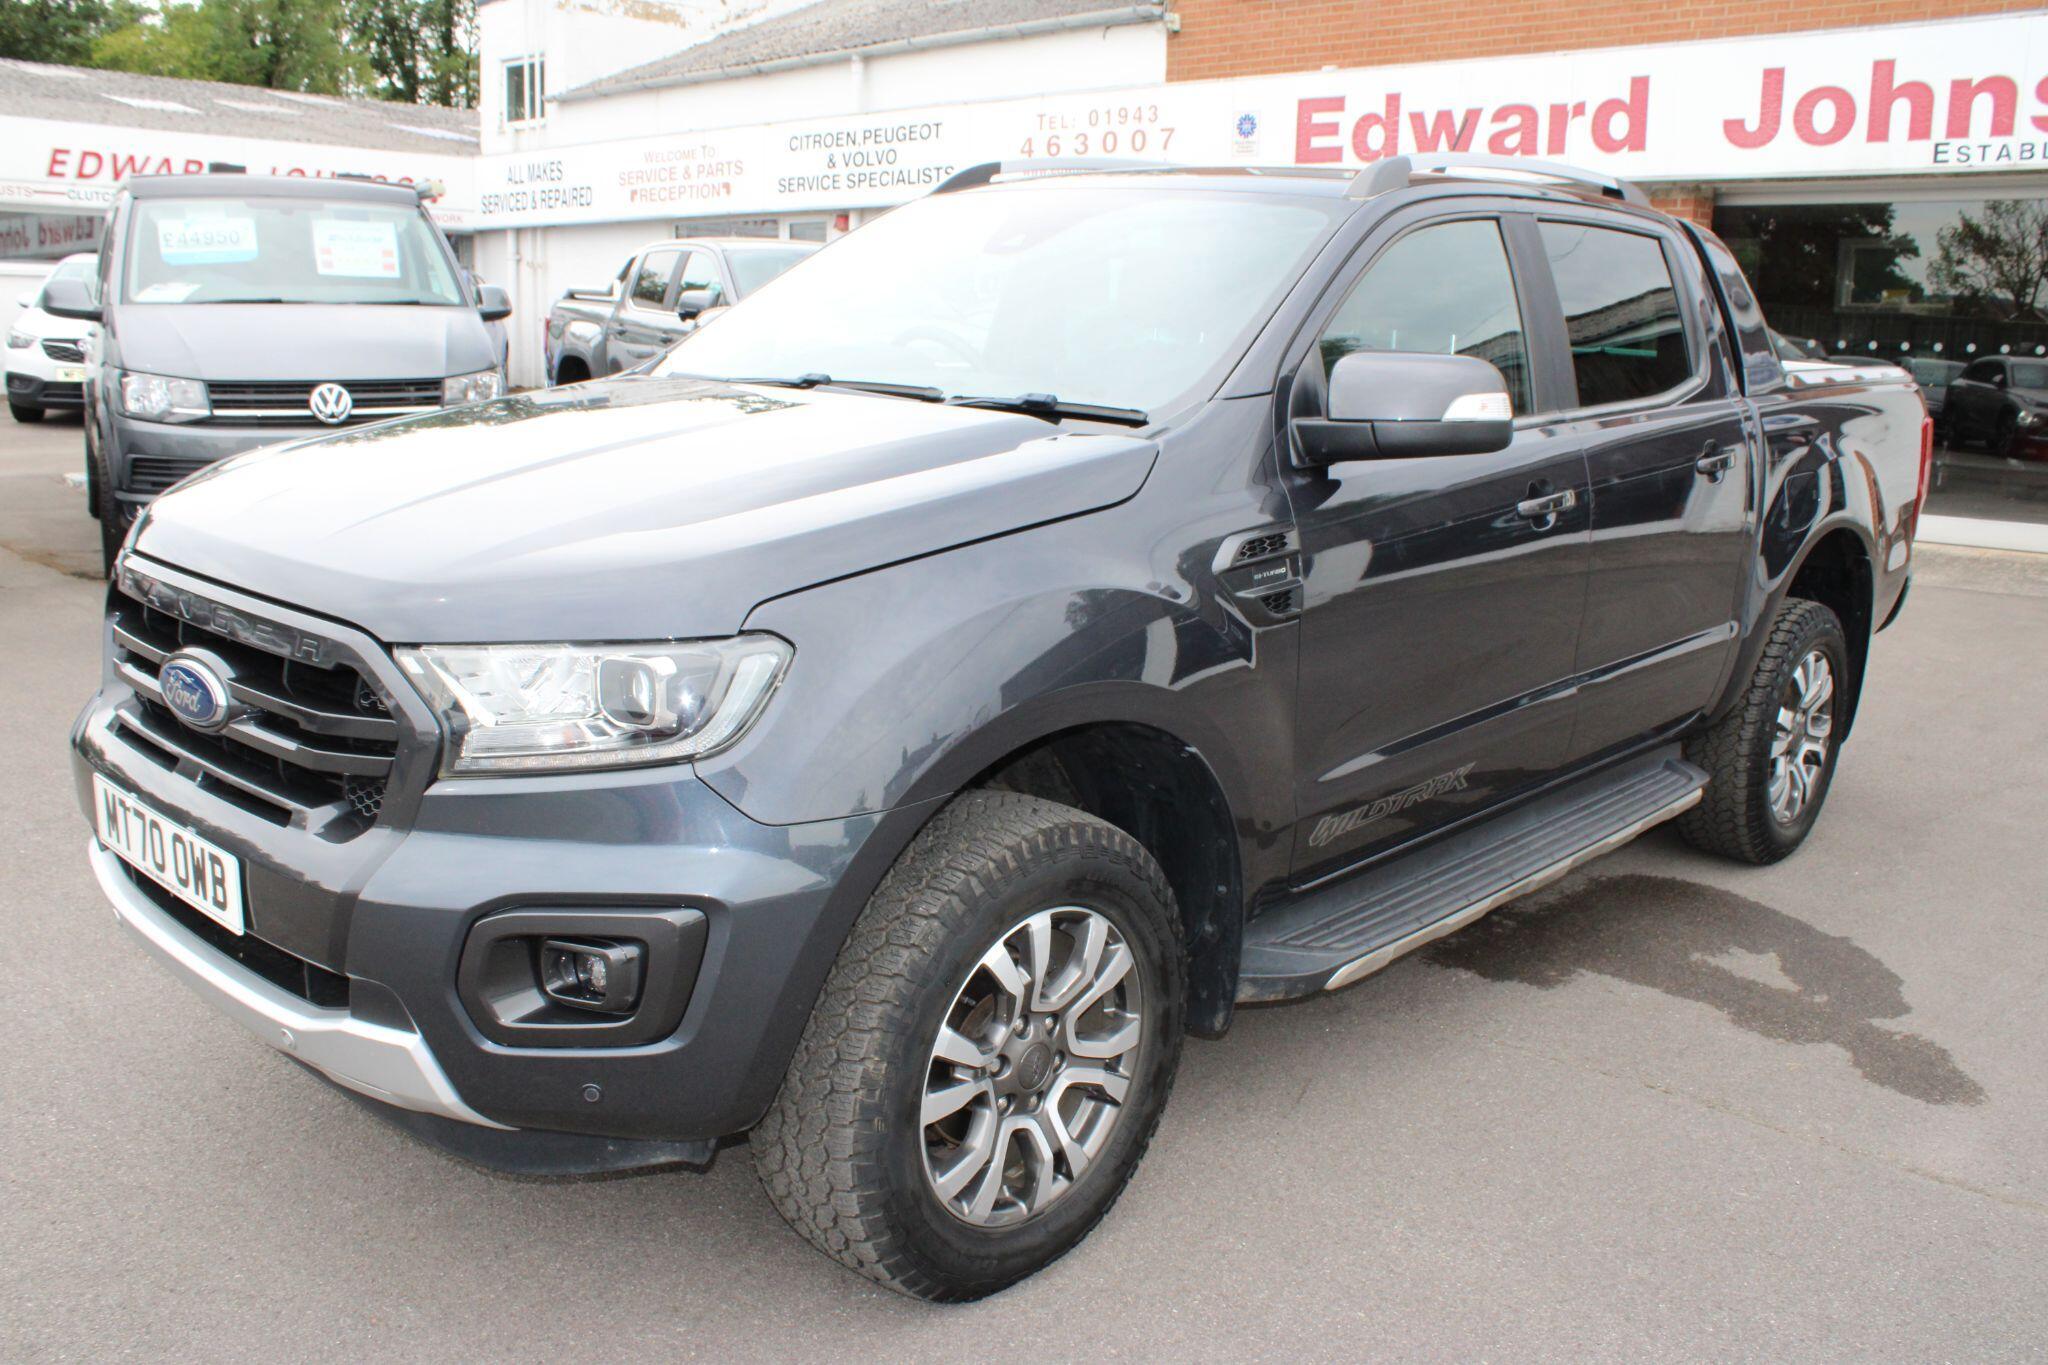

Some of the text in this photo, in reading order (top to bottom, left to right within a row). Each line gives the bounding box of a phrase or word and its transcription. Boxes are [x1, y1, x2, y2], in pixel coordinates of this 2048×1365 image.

[1088, 105, 1159, 128] 01943
[1295, 75, 1651, 163] Edward
[46, 148, 205, 182] EDWAR
[644, 148, 698, 163] WELCOME
[827, 149, 898, 169] & VOLVO
[507, 160, 564, 185] ALL MAKES
[619, 160, 744, 186] SERVICE & PARTS
[778, 174, 841, 194] SERVICE
[67, 187, 115, 202] CLUTC
[481, 186, 593, 215] SERVICED & REPAIRED
[640, 183, 721, 203] RECEPTION
[166, 669, 203, 713] Ford
[1309, 761, 1478, 847] WILDTRAK
[103, 787, 228, 912] MT70 OWB
